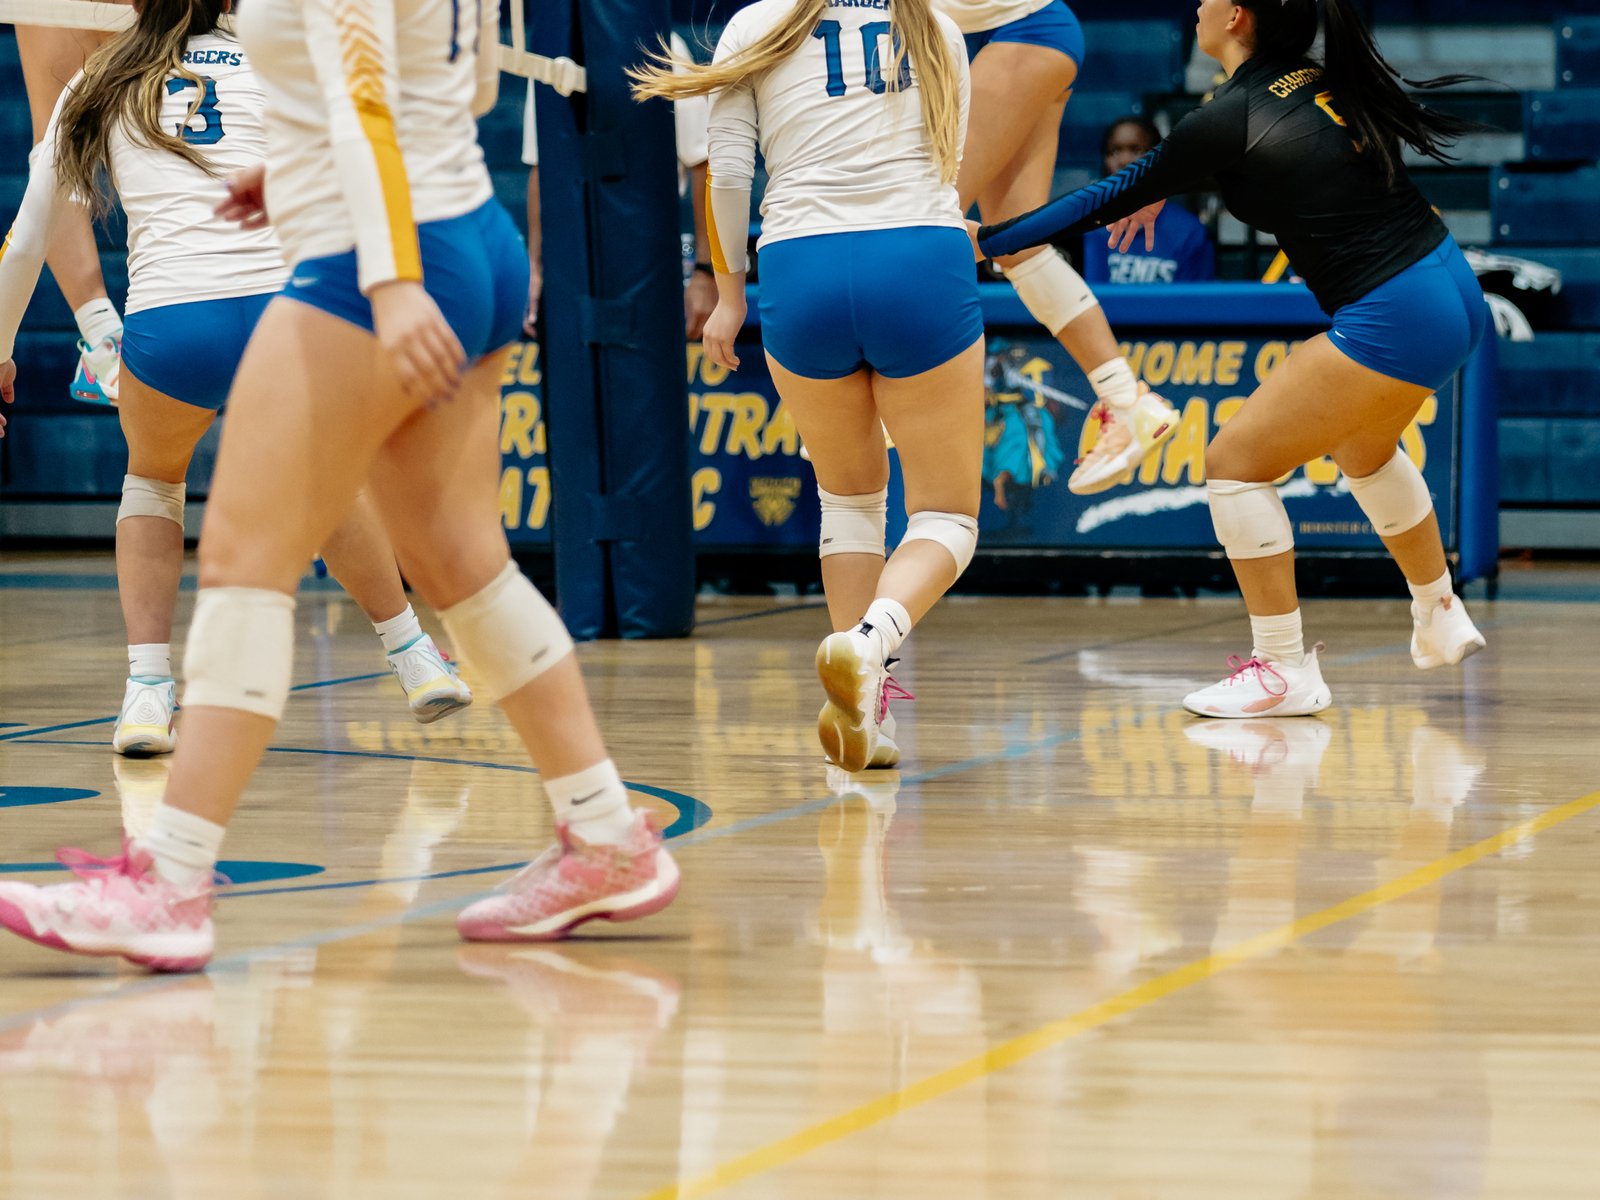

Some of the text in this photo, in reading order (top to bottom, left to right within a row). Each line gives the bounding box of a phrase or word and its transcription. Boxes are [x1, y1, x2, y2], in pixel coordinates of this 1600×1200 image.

[810, 19, 913, 97] 10
[166, 76, 225, 144] 3
[1116, 341, 1306, 386] HOME O
